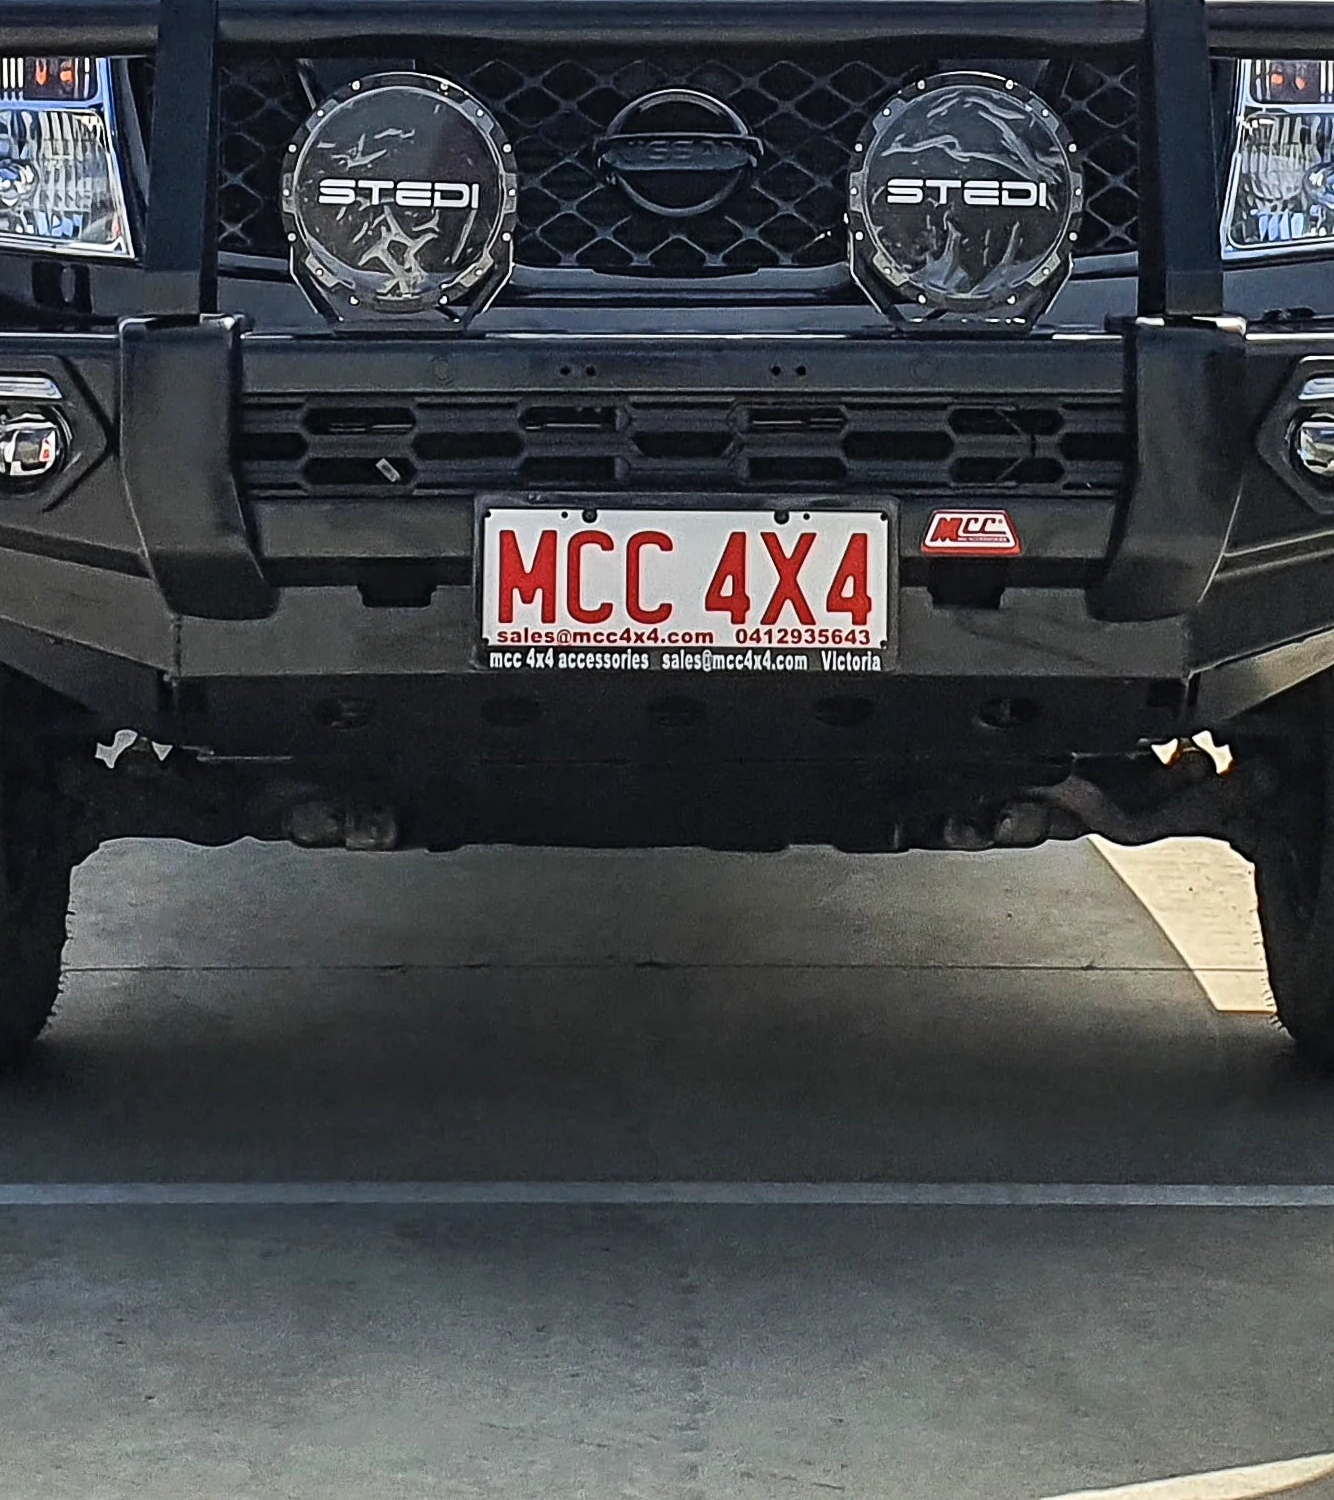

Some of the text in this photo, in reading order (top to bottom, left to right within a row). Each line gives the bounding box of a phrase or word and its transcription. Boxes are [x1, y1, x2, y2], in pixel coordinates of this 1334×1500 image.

[318, 179, 480, 209] STEDI
[887, 179, 1047, 207] STEDI
[498, 530, 873, 626] MCC 4X4
[497, 627, 871, 646] sales@mcc4x4.com 0412935643
[489, 653, 522, 668] mcc
[526, 649, 554, 668] 4x4
[558, 650, 650, 671] accessories
[821, 651, 881, 672] Victoria
